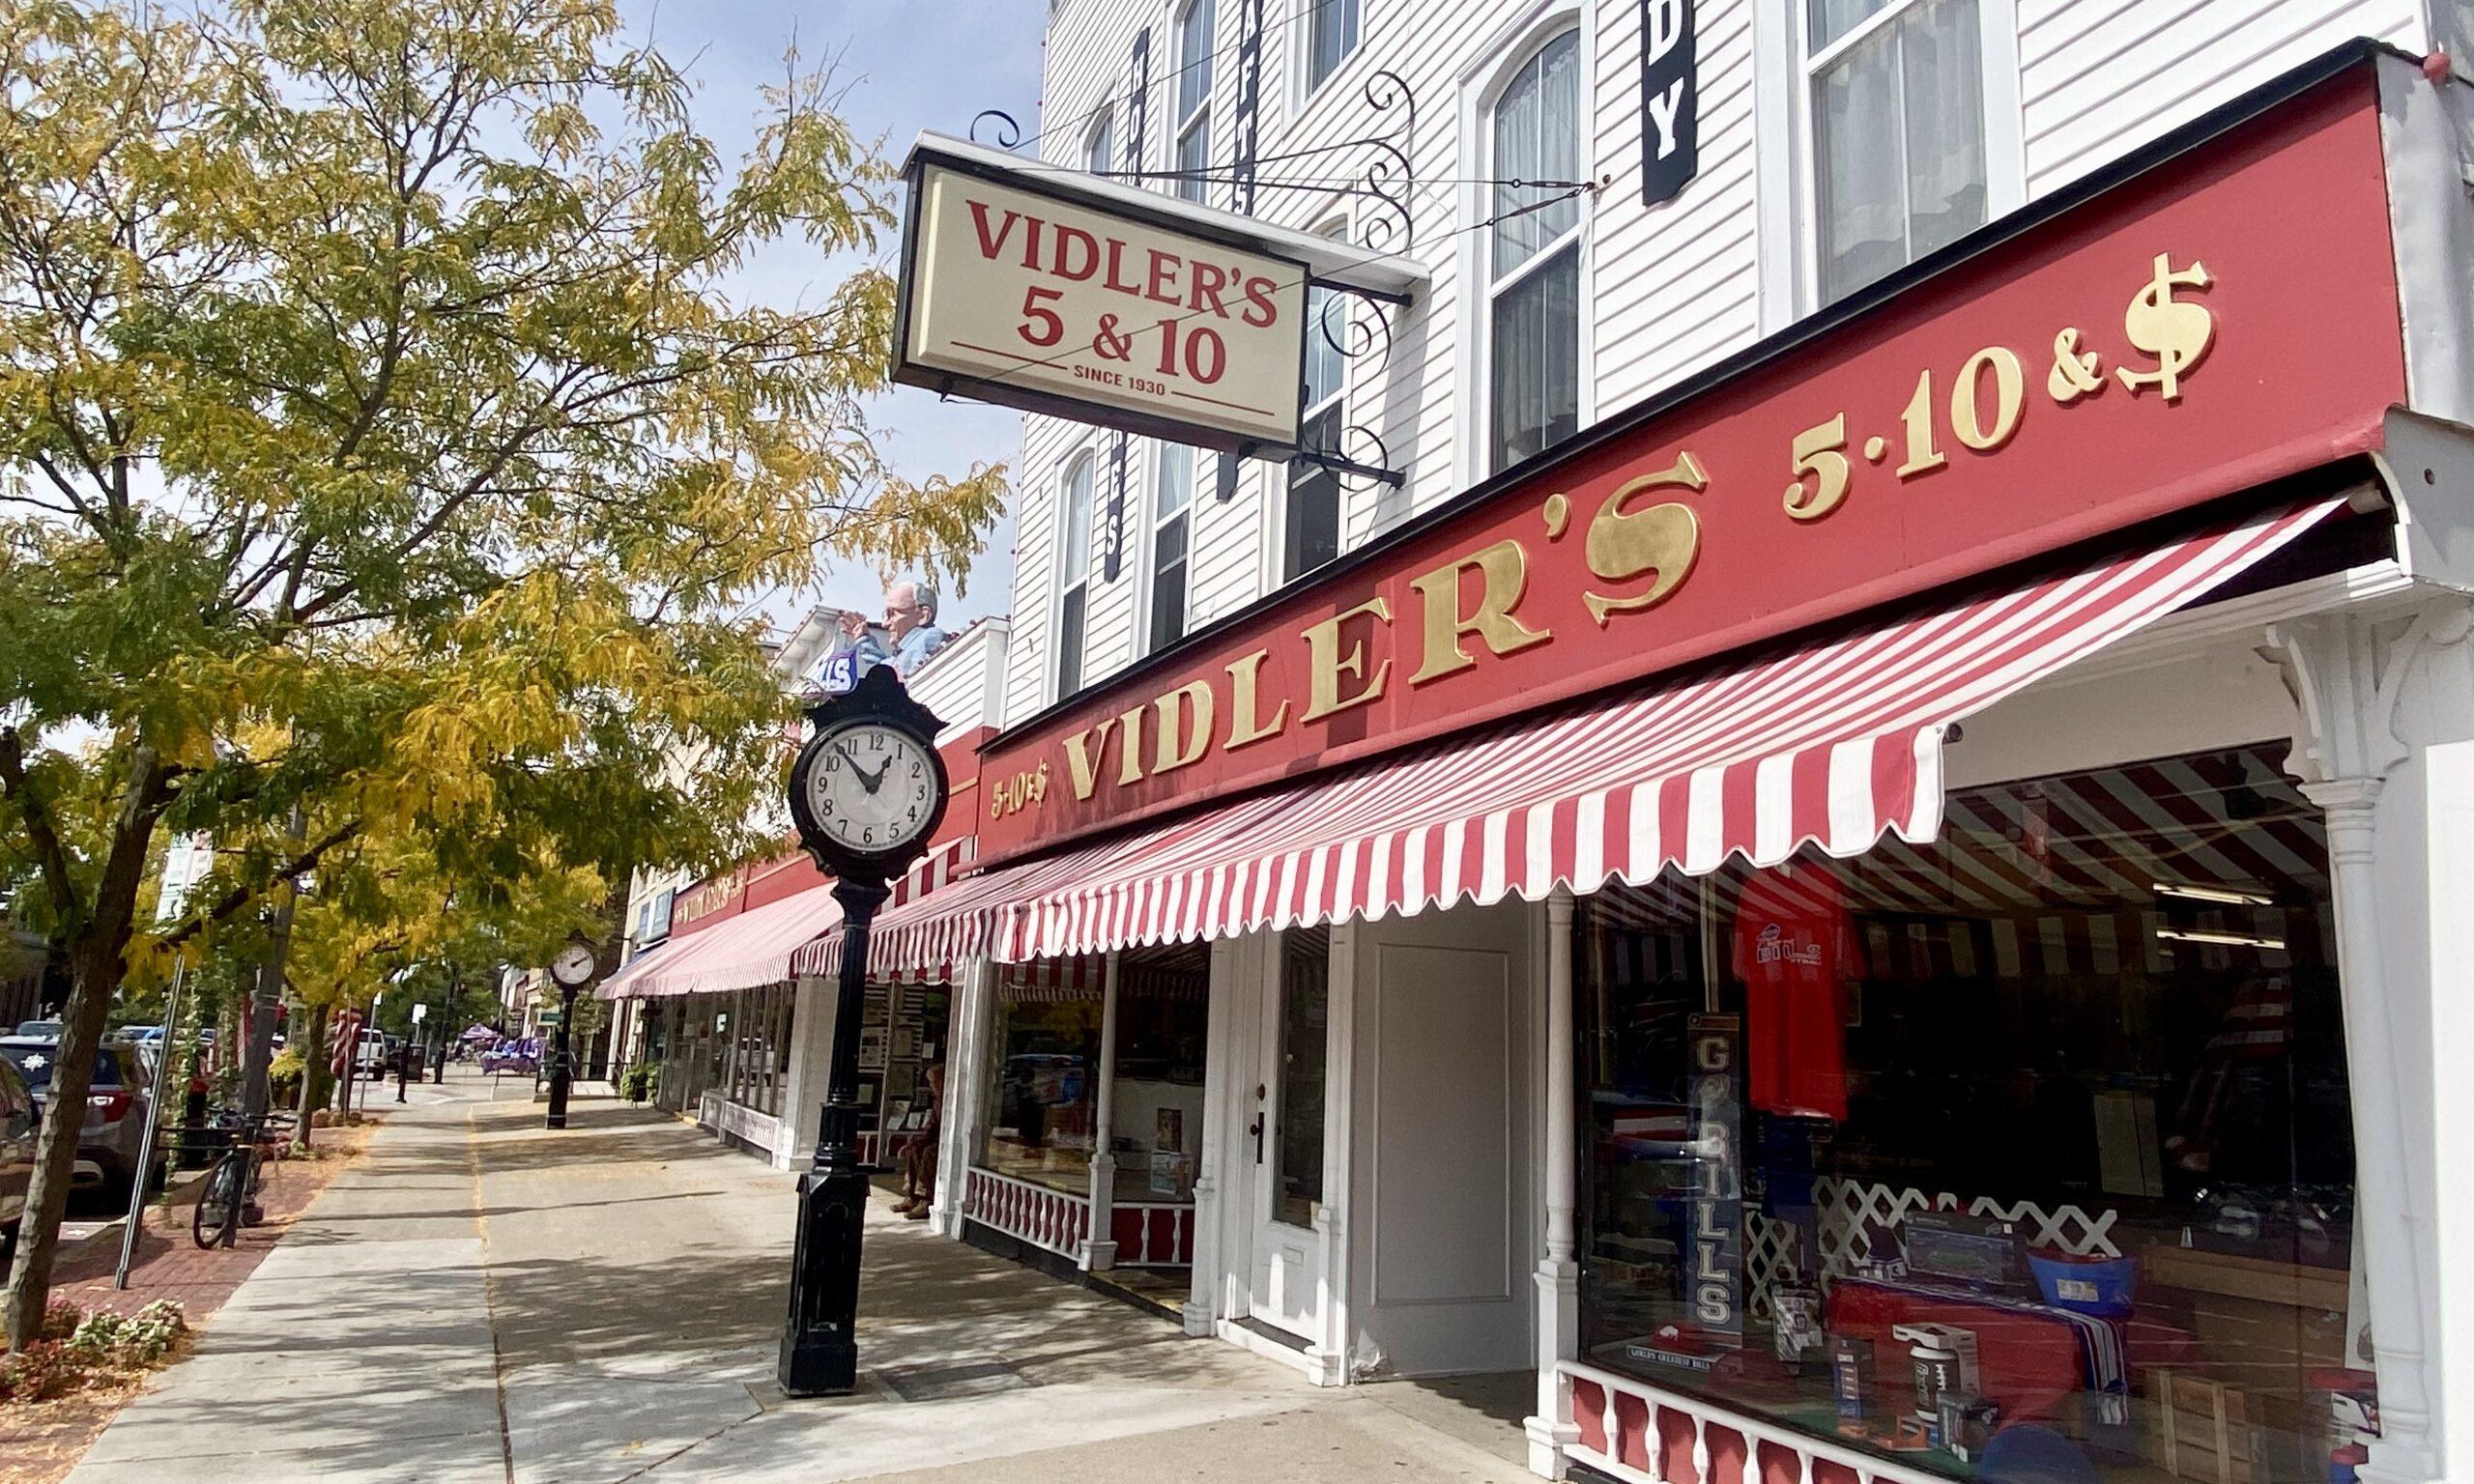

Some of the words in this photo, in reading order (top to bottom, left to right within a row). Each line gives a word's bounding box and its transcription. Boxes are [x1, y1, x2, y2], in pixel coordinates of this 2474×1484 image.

[966, 200, 1278, 328] VIDLER'S
[1018, 285, 1064, 347] 5
[1093, 313, 1133, 362] &
[1156, 319, 1226, 385] 10
[1074, 365, 1122, 386] SINCE
[1128, 377, 1165, 396] 1930
[1063, 450, 1708, 801] VIDLER'S
[848, 739, 857, 755] 11
[870, 734, 884, 751] 12
[897, 743, 903, 760] 1
[825, 756, 840, 772] 10
[911, 761, 921, 778] 2
[819, 777, 827, 793] 9
[917, 785, 925, 801] 3
[822, 799, 833, 816] 8
[906, 805, 917, 821] 4
[838, 819, 848, 836] 7
[863, 827, 873, 842] 6
[889, 822, 899, 839] 5
[1697, 1121, 1731, 1325] BILLS
